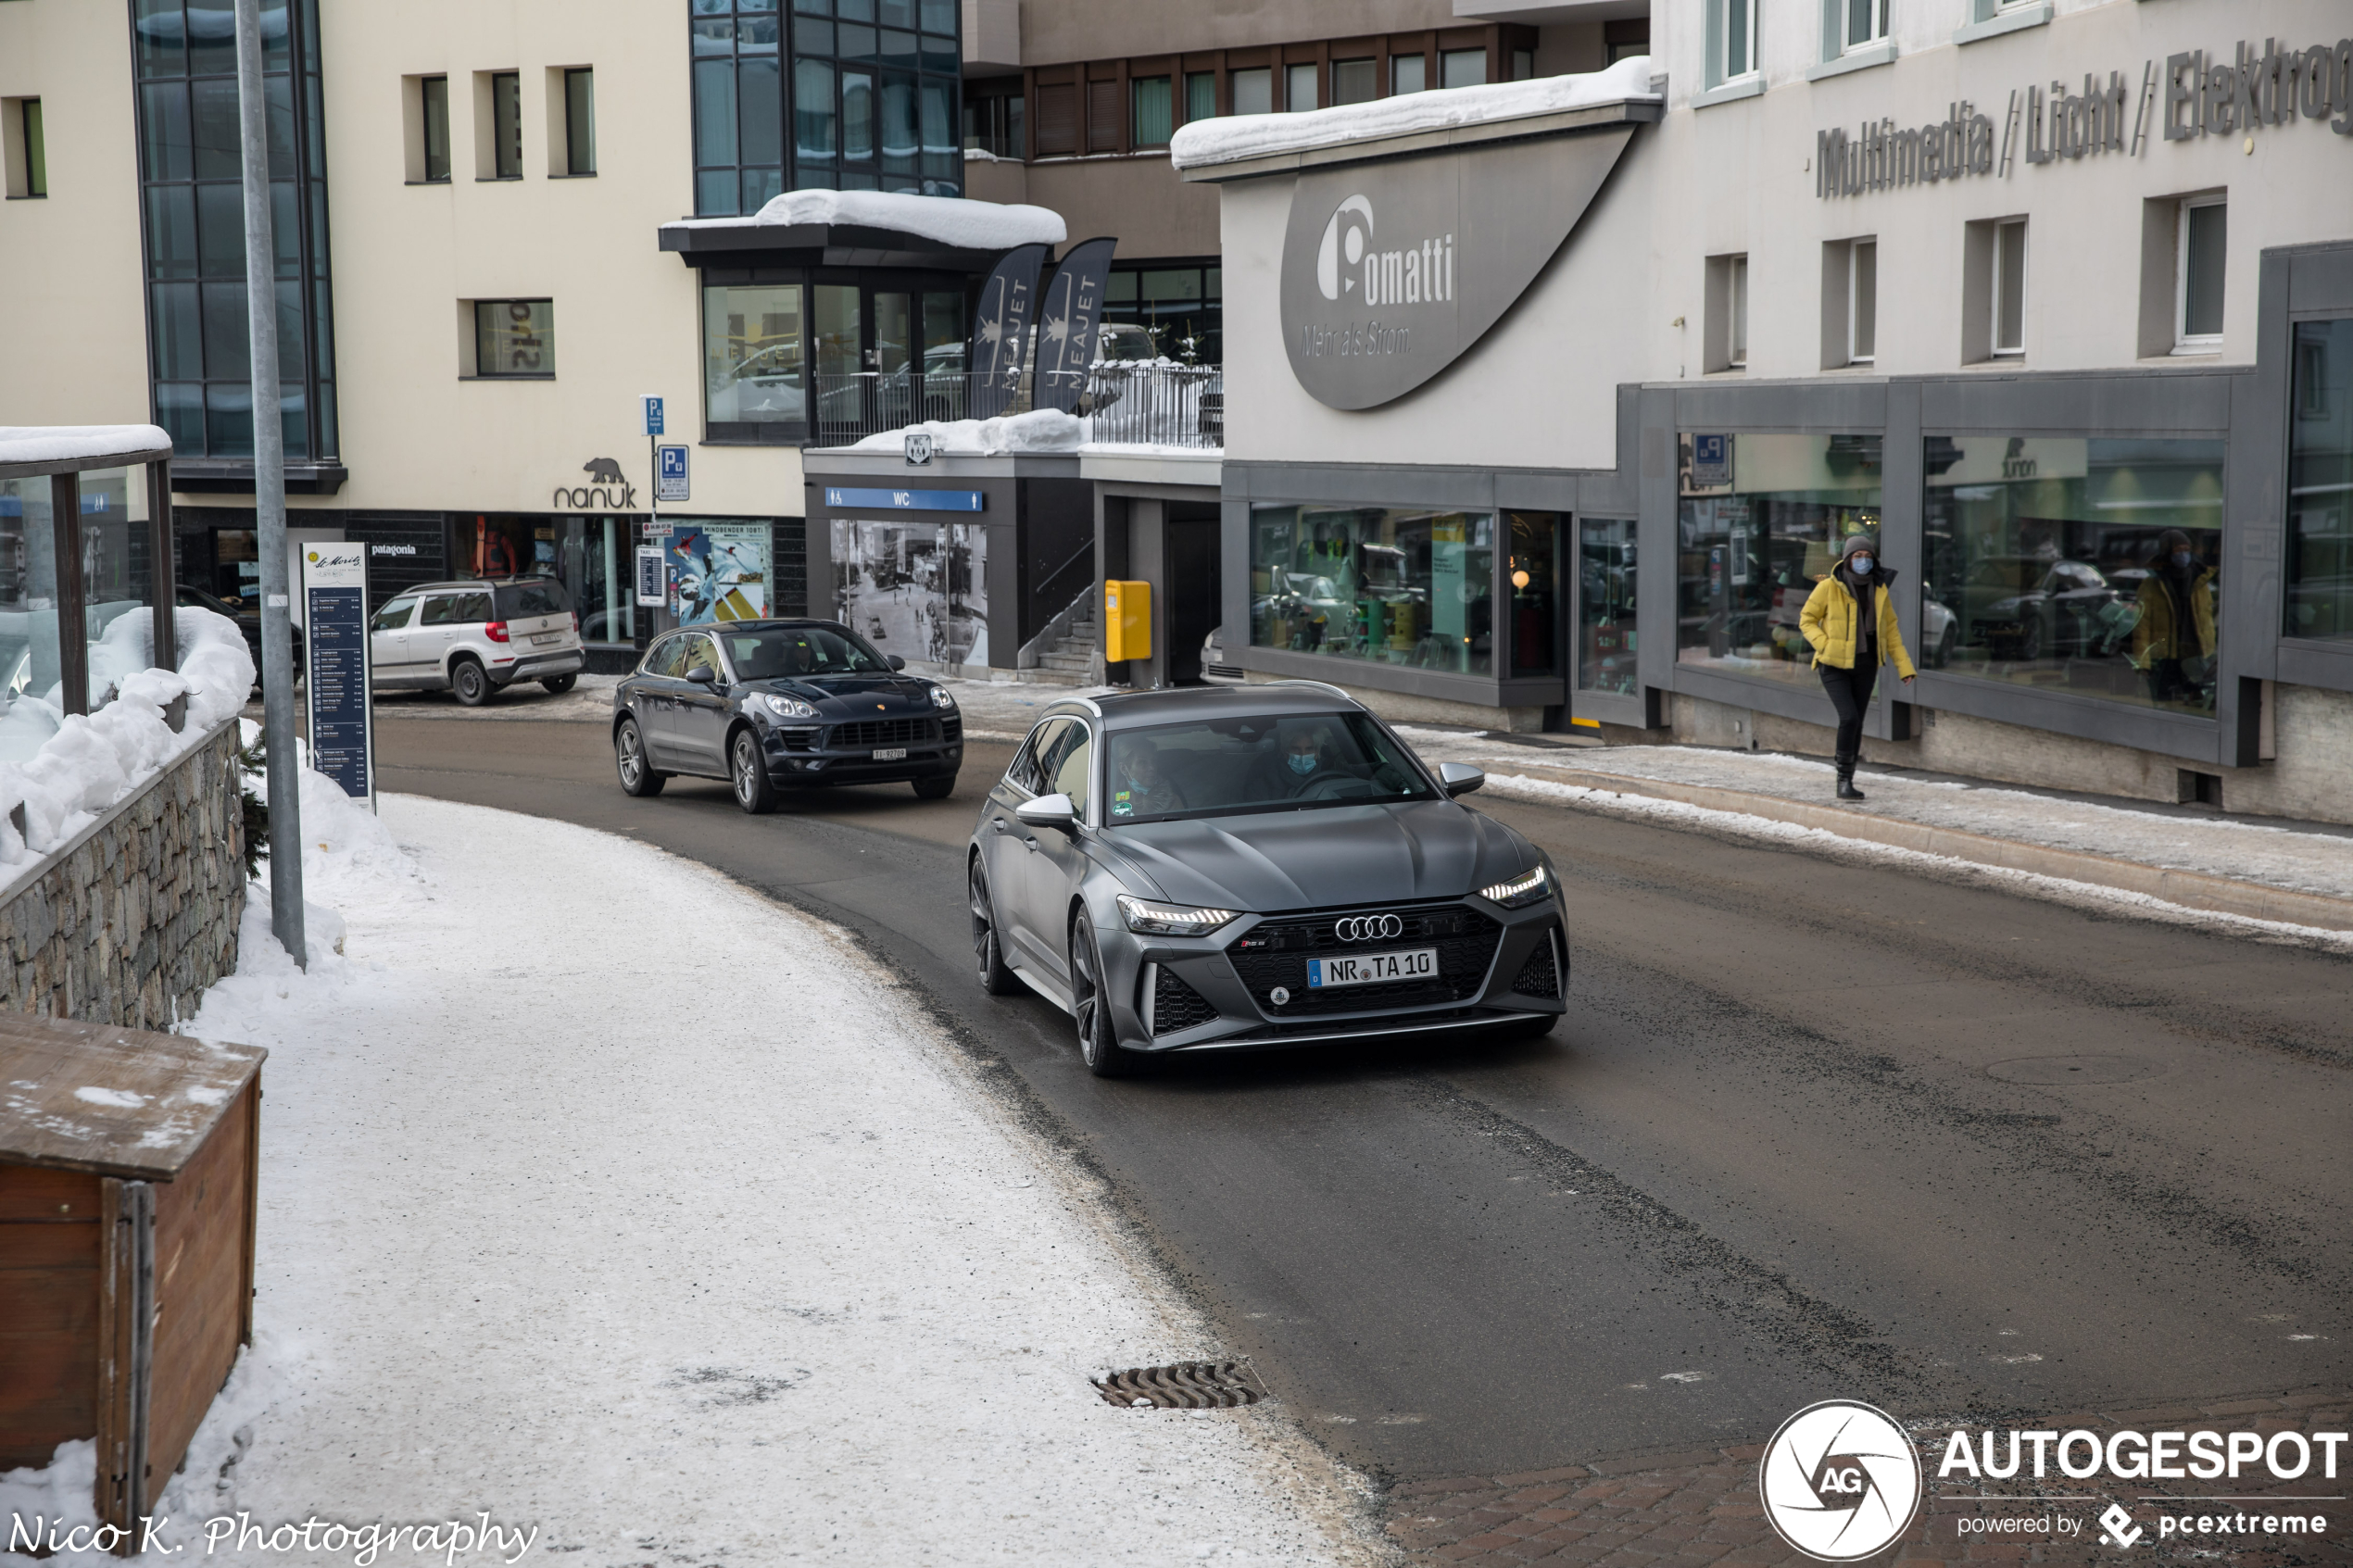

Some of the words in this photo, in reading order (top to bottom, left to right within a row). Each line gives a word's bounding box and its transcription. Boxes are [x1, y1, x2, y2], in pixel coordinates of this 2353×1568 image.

[1817, 100, 1991, 198] Multimedia
[2026, 71, 2124, 164] Licht
[1069, 275, 1096, 390] MEAJET
[1301, 324, 1338, 358] Mehr
[1342, 322, 1362, 356] als
[649, 399, 658, 416] P
[913, 437, 923, 446] WC
[665, 451, 675, 472] P
[554, 482, 636, 508] nanuk
[893, 492, 910, 507] WC
[372, 545, 416, 556] patagonia
[326, 556, 361, 567] Moritz
[670, 569, 677, 582] P
[1330, 960, 1358, 982] NR
